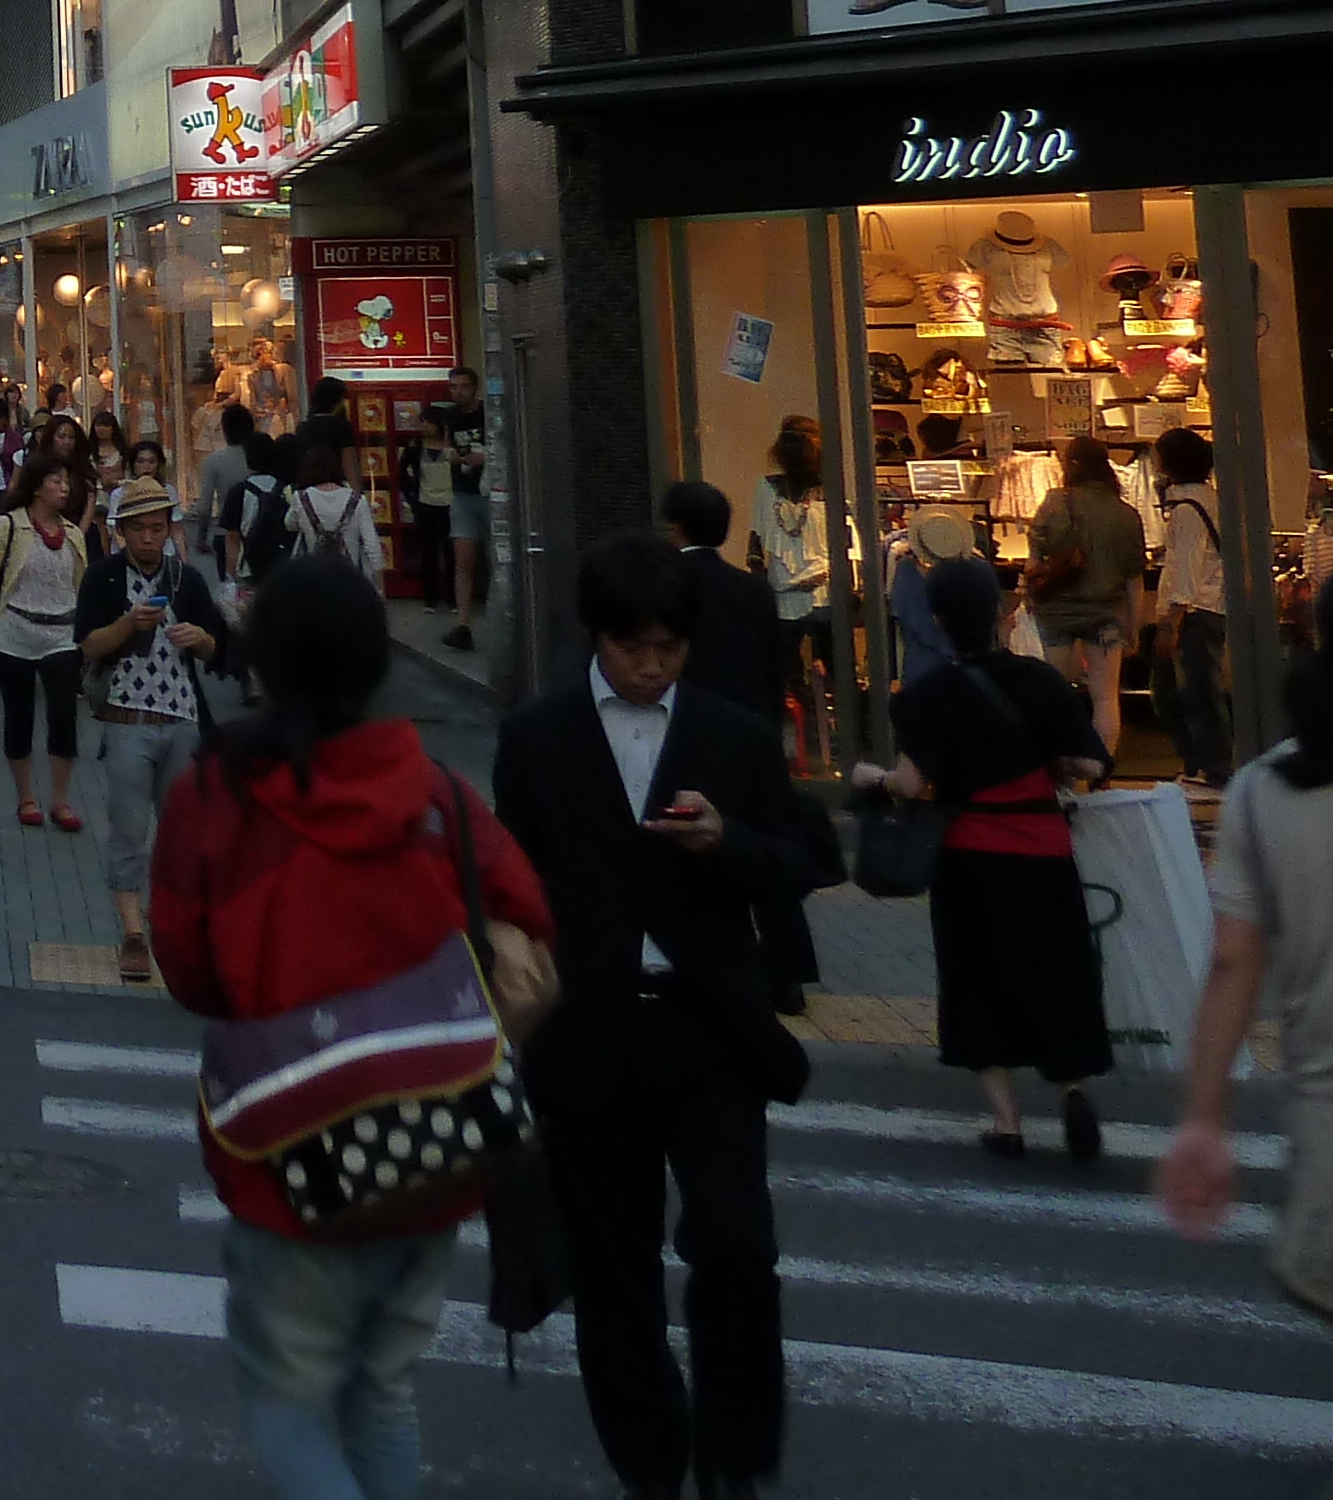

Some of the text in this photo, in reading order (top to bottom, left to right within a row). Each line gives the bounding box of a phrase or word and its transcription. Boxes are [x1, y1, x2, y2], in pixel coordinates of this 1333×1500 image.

[889, 108, 1078, 184] indio
[190, 175, 270, 198] 酒・たばこ
[323, 245, 441, 263] HOT PEPPER
